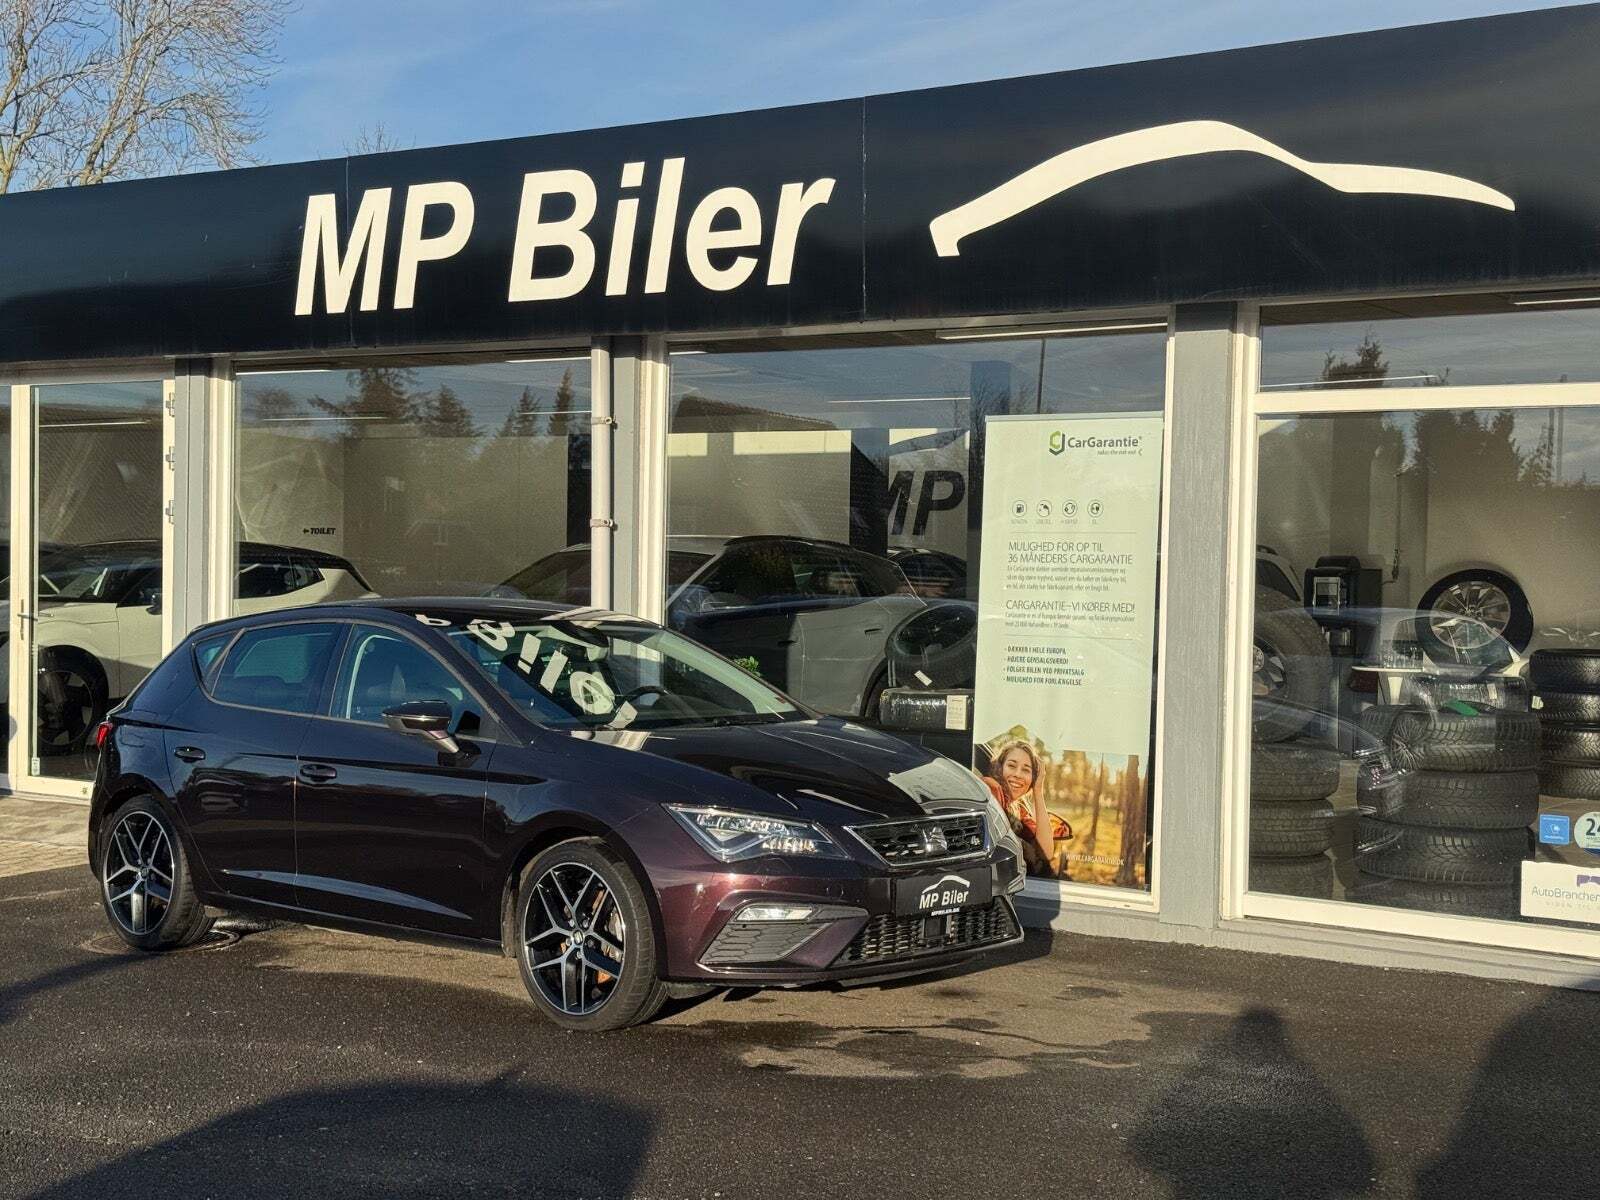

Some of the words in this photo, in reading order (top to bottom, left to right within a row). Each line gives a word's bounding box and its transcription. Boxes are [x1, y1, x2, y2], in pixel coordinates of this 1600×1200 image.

[295, 181, 475, 316] MP
[508, 157, 836, 302] Biler
[1067, 436, 1139, 449] CarGarantie
[310, 527, 336, 535] TOILET
[1008, 541, 1055, 552] MULIGHED
[1056, 542, 1074, 552] FOR
[1076, 542, 1090, 553] OP
[1092, 542, 1104, 553] TIL
[1008, 553, 1019, 563] 36
[1020, 552, 1068, 564] MÅNEDERS
[1069, 554, 1133, 565] CARGARANTIE
[1081, 603, 1110, 612] KØRER
[1111, 603, 1135, 613] MED!
[919, 892, 939, 909] MP
[941, 890, 969, 906] Biler
